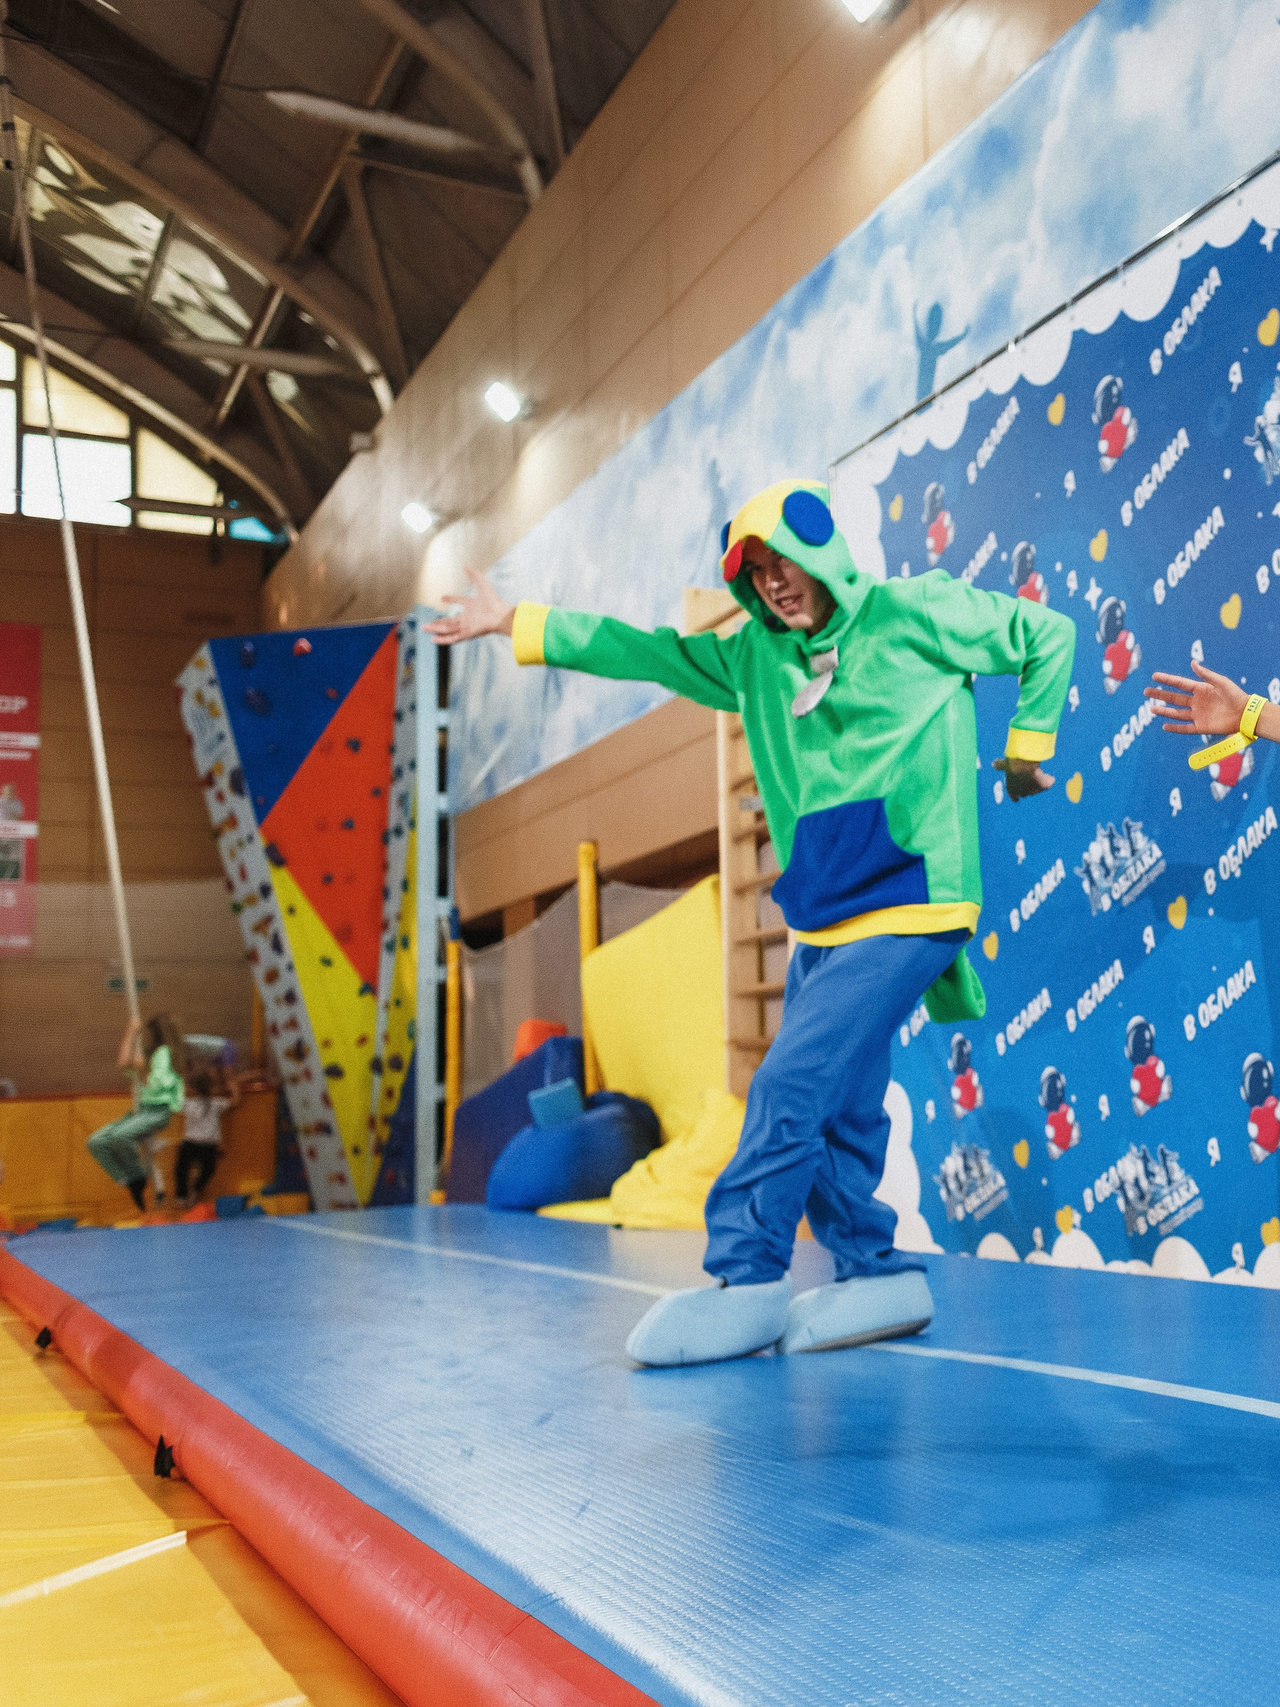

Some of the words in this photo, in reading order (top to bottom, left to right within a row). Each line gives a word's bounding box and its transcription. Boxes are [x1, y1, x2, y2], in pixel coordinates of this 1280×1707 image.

[1167, 506, 1225, 588] ОБЛАКА
[1256, 565, 1270, 594] В
[1219, 807, 1278, 880] ОБЛАКА
[1183, 1014, 1196, 1041] В
[1198, 960, 1256, 1028] ОБЛАКА
